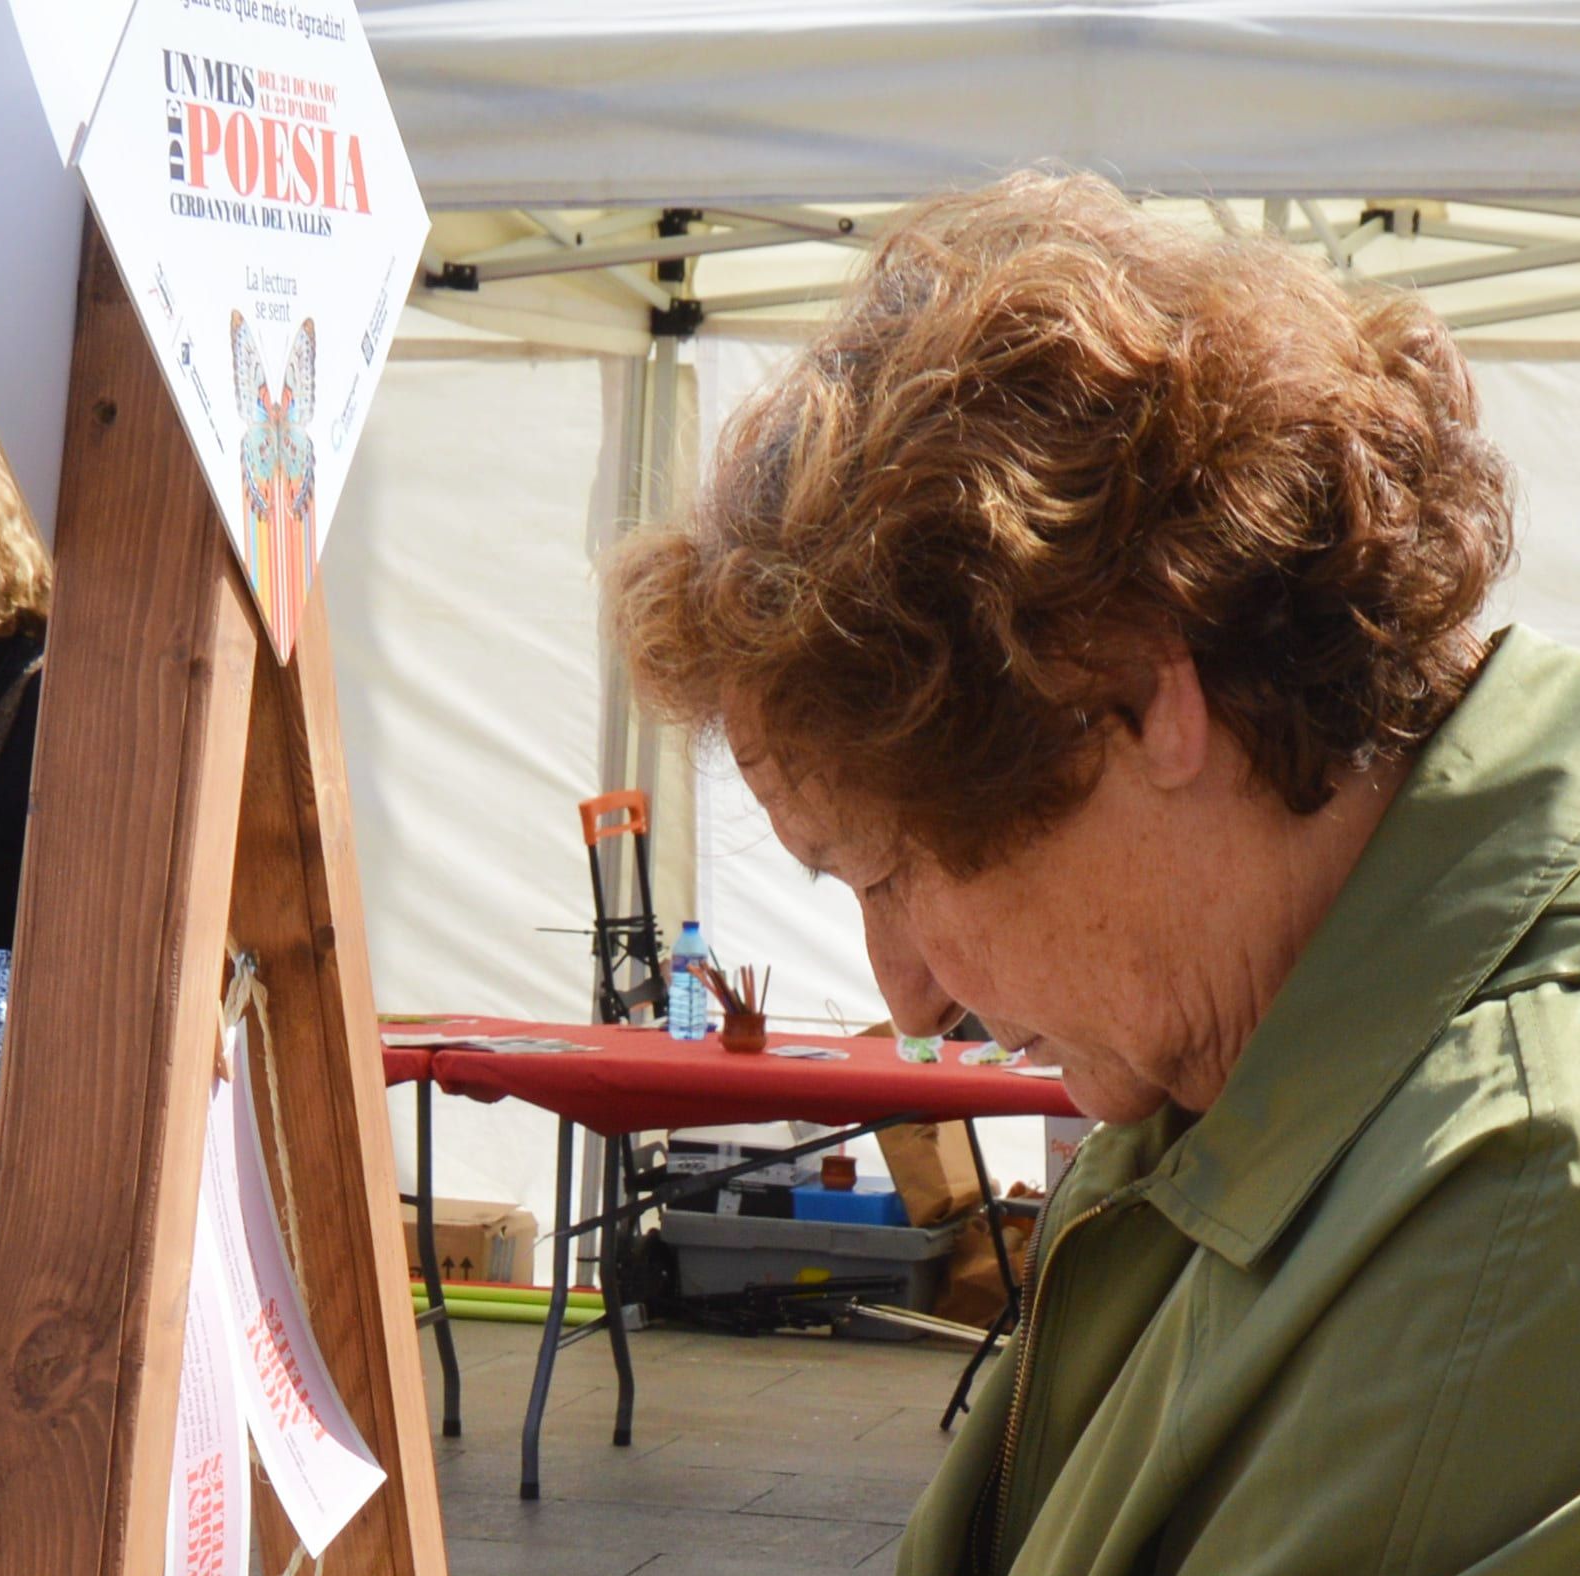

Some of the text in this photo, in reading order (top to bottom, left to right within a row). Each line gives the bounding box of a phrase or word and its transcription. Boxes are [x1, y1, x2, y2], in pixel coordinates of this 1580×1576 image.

[235, 1, 258, 22] que
[262, 2, 287, 27] més
[289, 5, 346, 42] t'agradin!
[163, 48, 255, 109] UN MES
[258, 70, 338, 106] DEL 21 DE MARÇ
[259, 93, 330, 124] AL 23 D'ABRIL
[166, 99, 186, 182] DE
[184, 102, 373, 216] POESIA
[170, 192, 332, 238] CERDANYOLA DEL VALLÈS
[246, 266, 298, 297] La lectura
[255, 301, 291, 322] se sent
